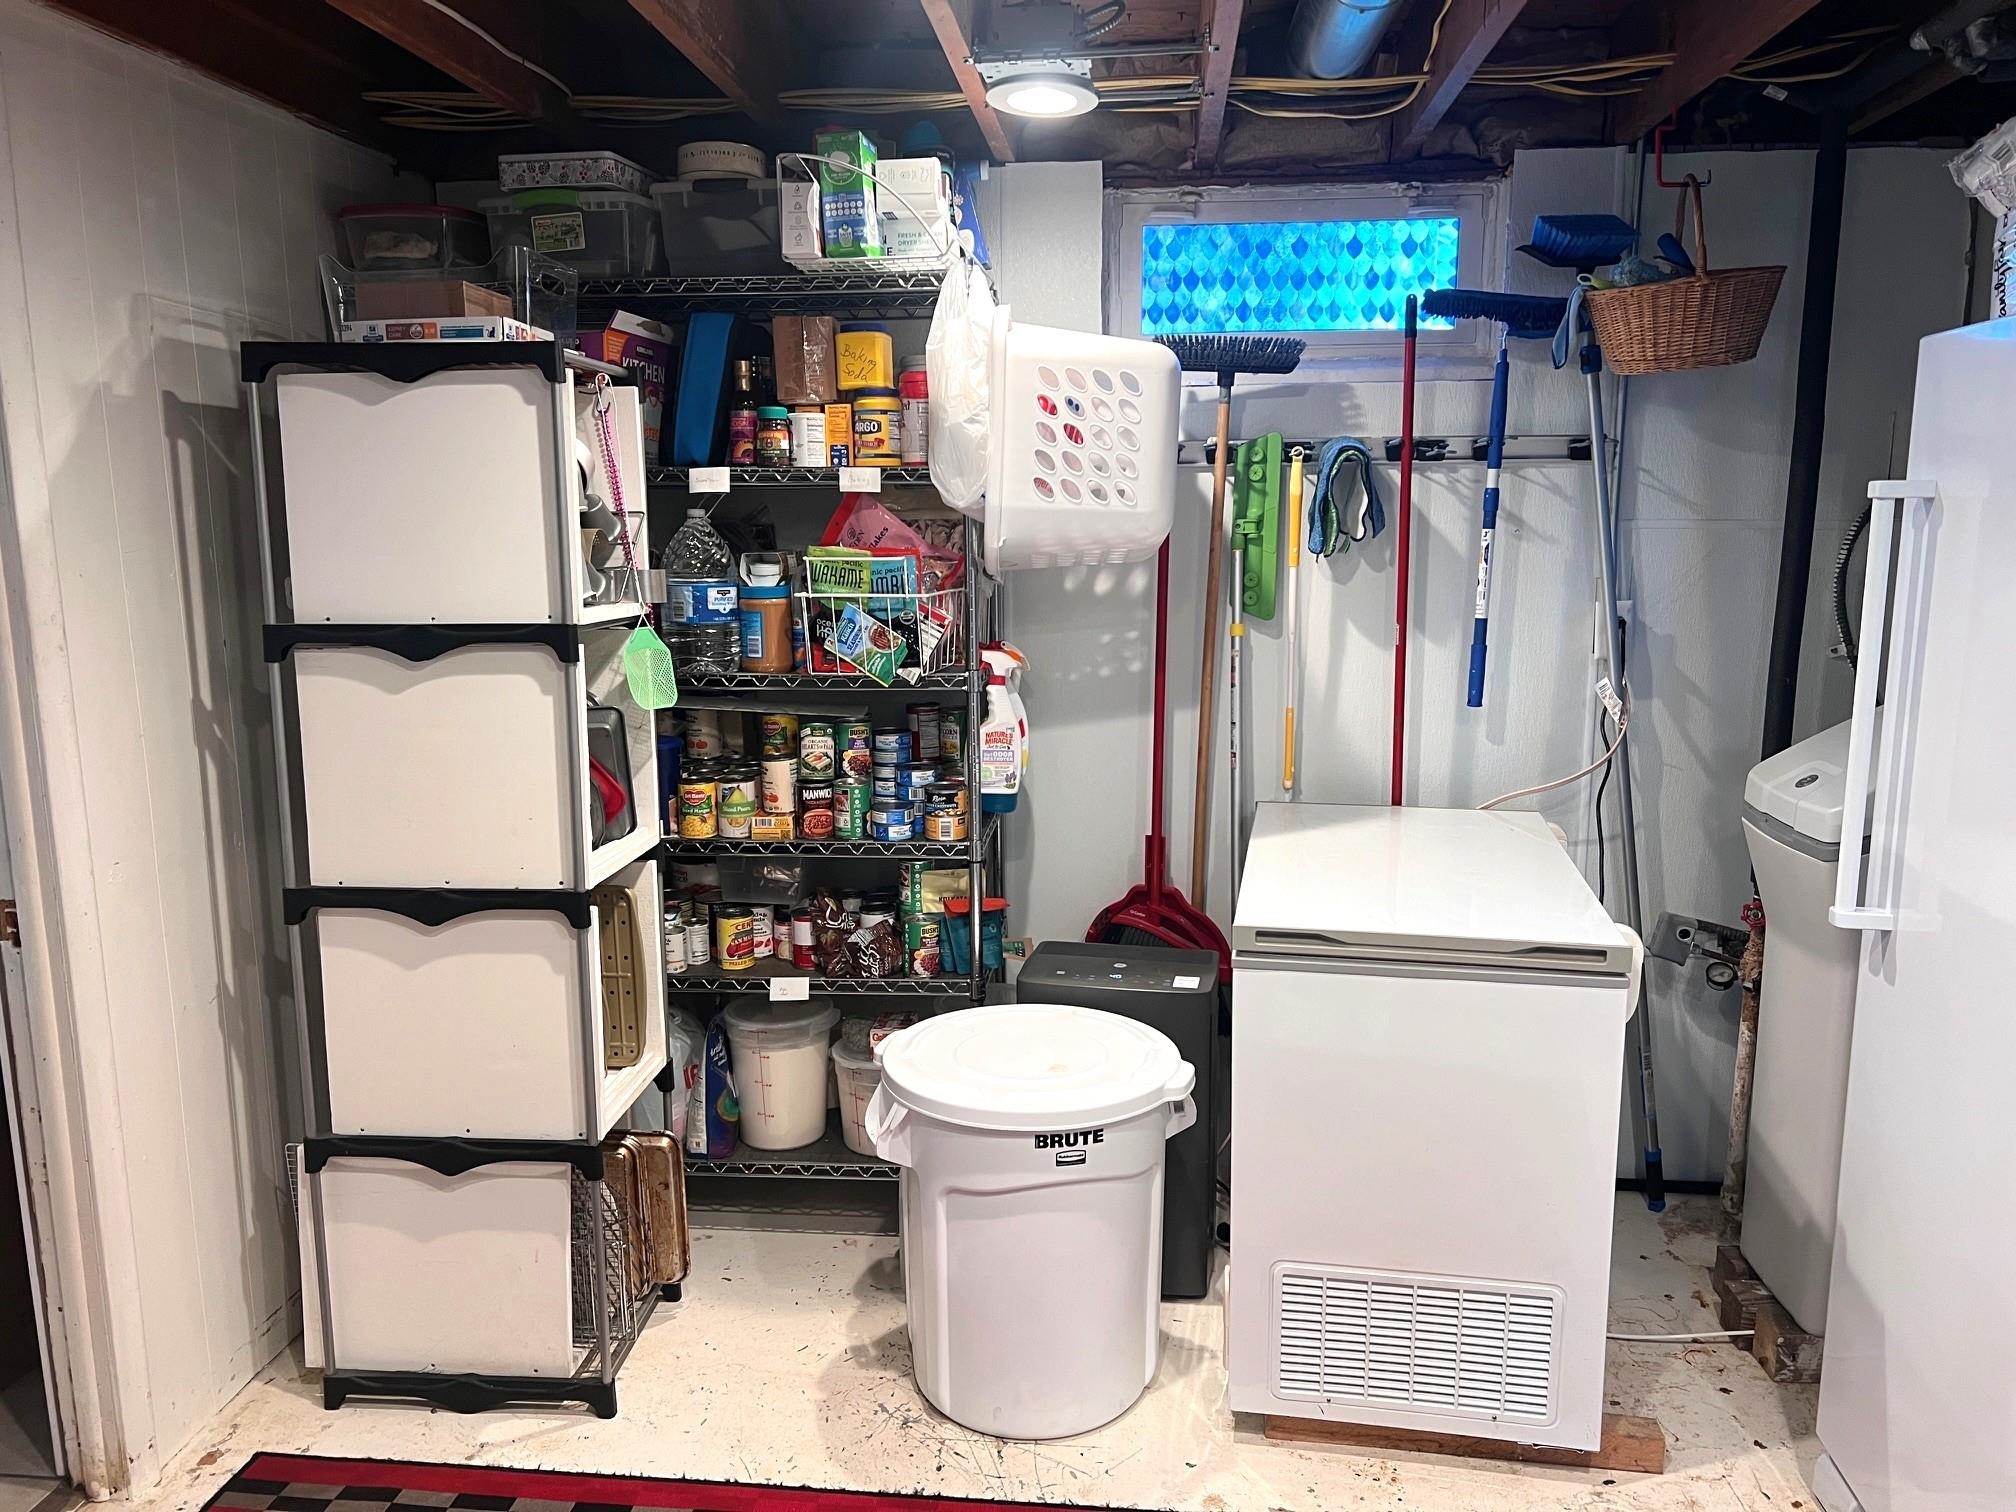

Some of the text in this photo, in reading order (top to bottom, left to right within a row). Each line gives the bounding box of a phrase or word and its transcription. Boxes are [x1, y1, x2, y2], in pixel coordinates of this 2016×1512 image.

[840, 344, 877, 377] Baking
[842, 363, 869, 384] Soda
[855, 421, 879, 433] ARGO
[811, 563, 864, 589] WAKAME
[842, 622, 855, 643] Ranch
[984, 738, 1013, 746] MIRACLE
[985, 730, 1014, 739] NATURE'S
[1034, 1128, 1104, 1149] BRUTE
